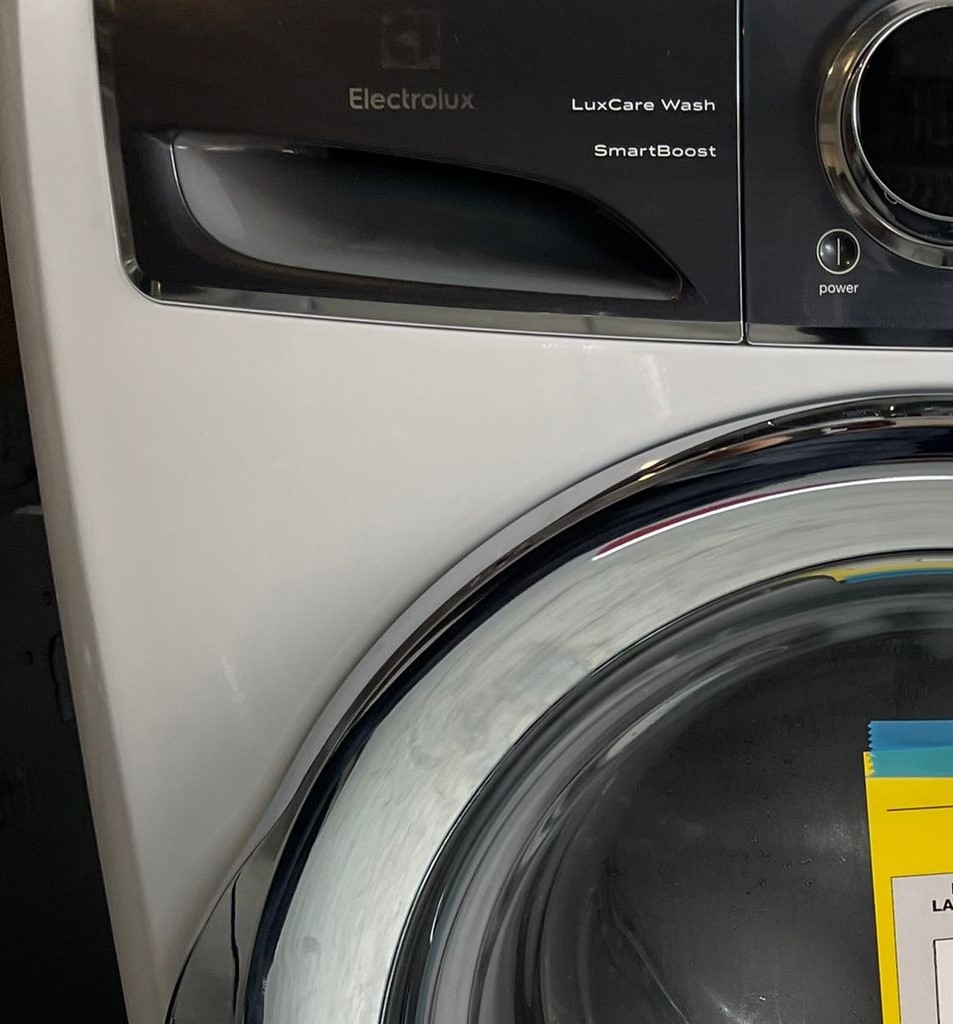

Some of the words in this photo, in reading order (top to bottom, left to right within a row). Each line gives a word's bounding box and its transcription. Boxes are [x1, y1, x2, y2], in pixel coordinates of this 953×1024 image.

[349, 88, 474, 111] Electrolux
[571, 98, 655, 112] LuxCare
[660, 99, 716, 112] Wash
[594, 144, 717, 158] SmartBoost
[818, 281, 859, 295] power
